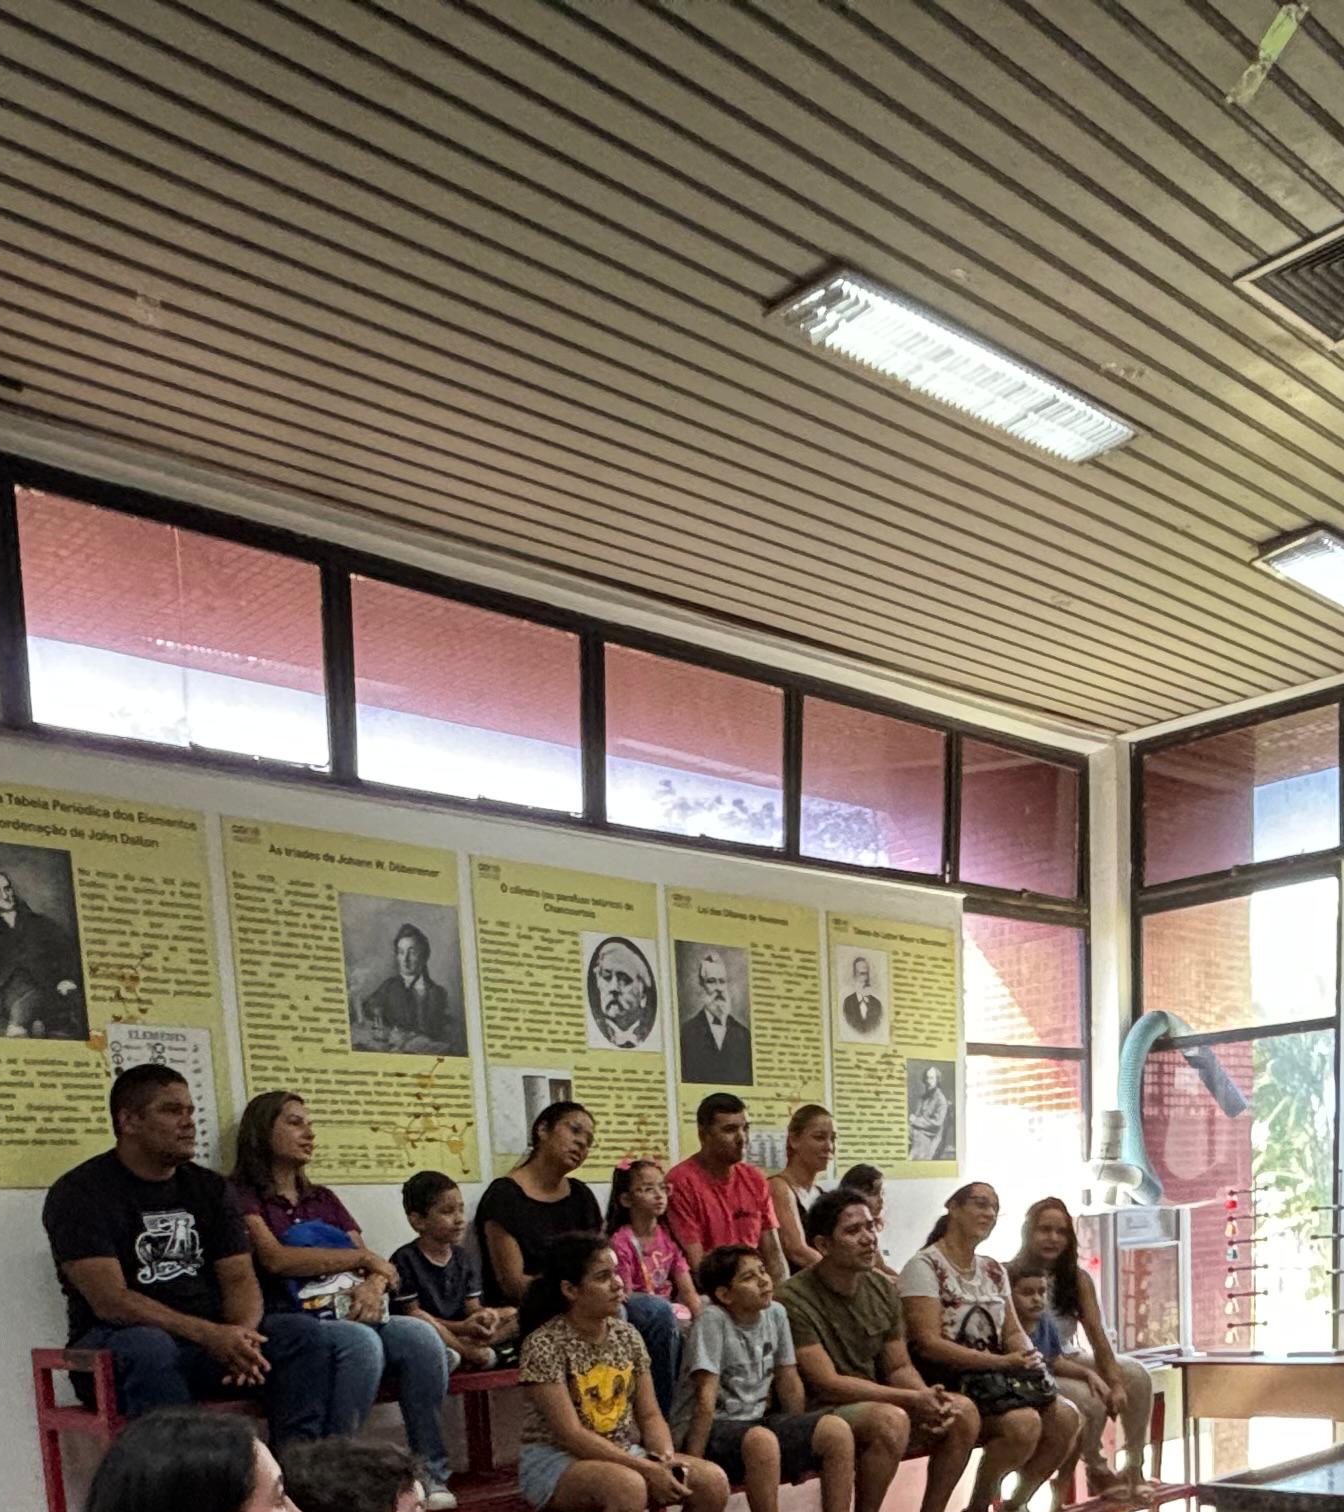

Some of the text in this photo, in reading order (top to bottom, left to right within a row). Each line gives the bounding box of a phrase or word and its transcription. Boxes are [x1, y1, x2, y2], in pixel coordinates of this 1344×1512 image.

[6, 792, 49, 810] Tabela
[112, 808, 134, 823] dos
[137, 811, 197, 832] Elementos
[69, 826, 85, 839] de
[88, 829, 118, 844] John
[120, 833, 160, 849] Dalton
